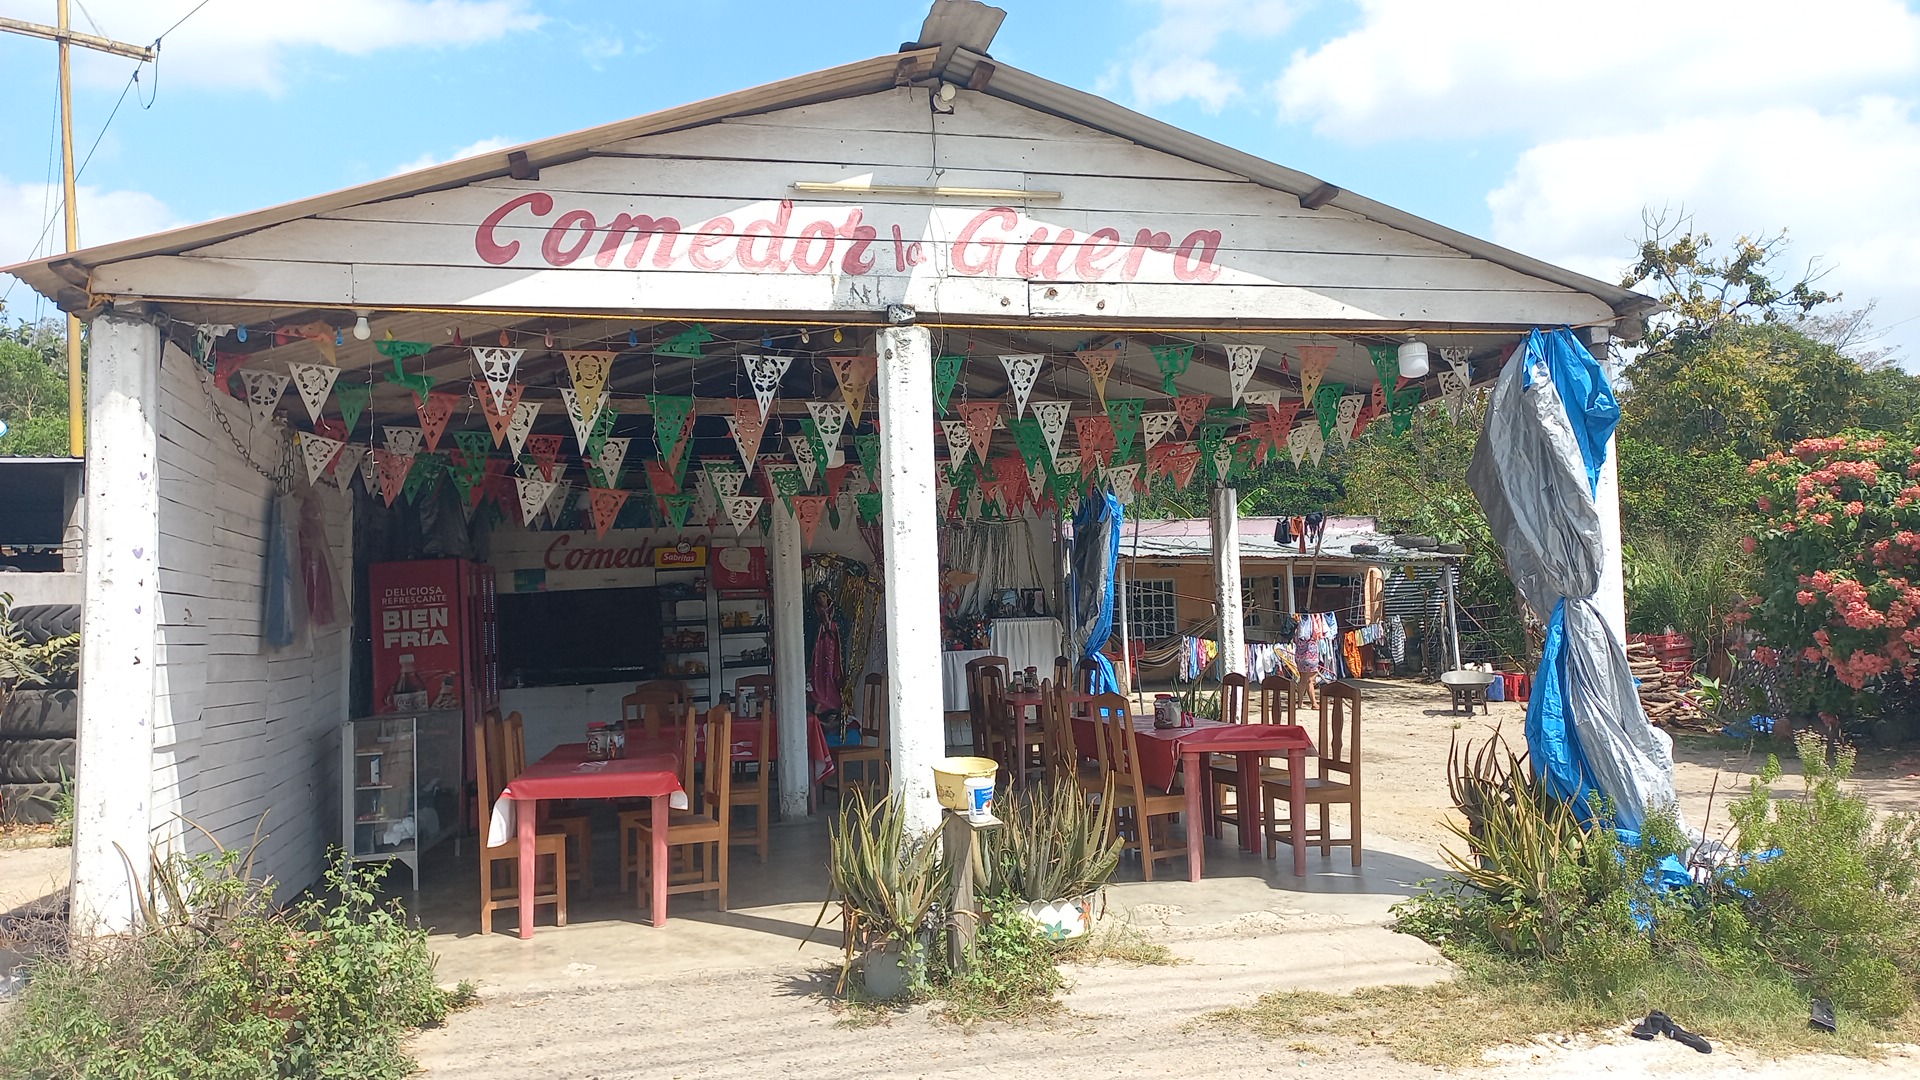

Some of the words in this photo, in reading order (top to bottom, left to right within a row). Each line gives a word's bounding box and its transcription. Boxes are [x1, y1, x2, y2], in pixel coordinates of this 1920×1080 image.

[476, 192, 875, 275] Comedor
[892, 224, 926, 272] la
[951, 207, 1221, 281] Guera
[663, 552, 695, 562] Sabritas
[385, 586, 443, 597] DELICIOSA
[382, 594, 447, 605] REFRESCANTE
[382, 607, 448, 630] BIEN
[383, 629, 449, 649] FRÍA
